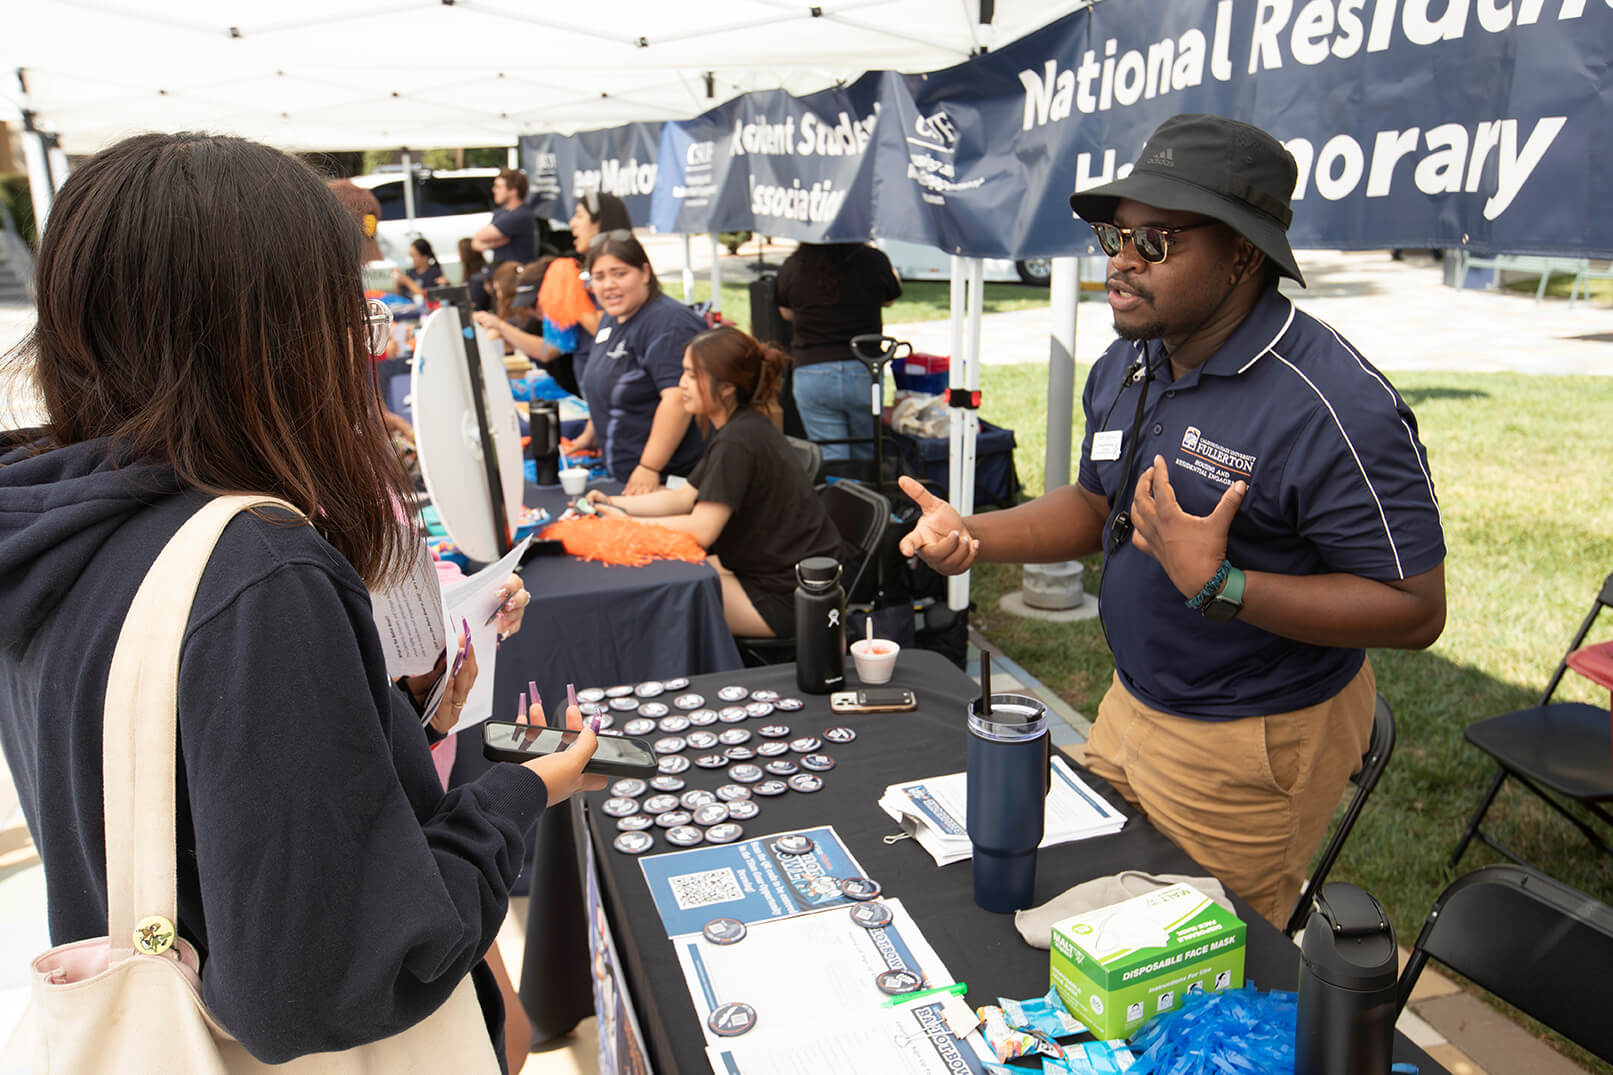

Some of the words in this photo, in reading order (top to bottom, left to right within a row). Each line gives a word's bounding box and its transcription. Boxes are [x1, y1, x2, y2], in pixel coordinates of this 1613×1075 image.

[1019, 0, 1233, 131] National
[1248, 0, 1613, 74] Resi
[1279, 115, 1567, 221] orary
[1196, 442, 1254, 472] FULLERTON
[1216, 469, 1231, 478] AND
[1122, 953, 1183, 981] DISPOSABLE
[1184, 945, 1209, 961] FACE
[1210, 935, 1236, 951] MASK
